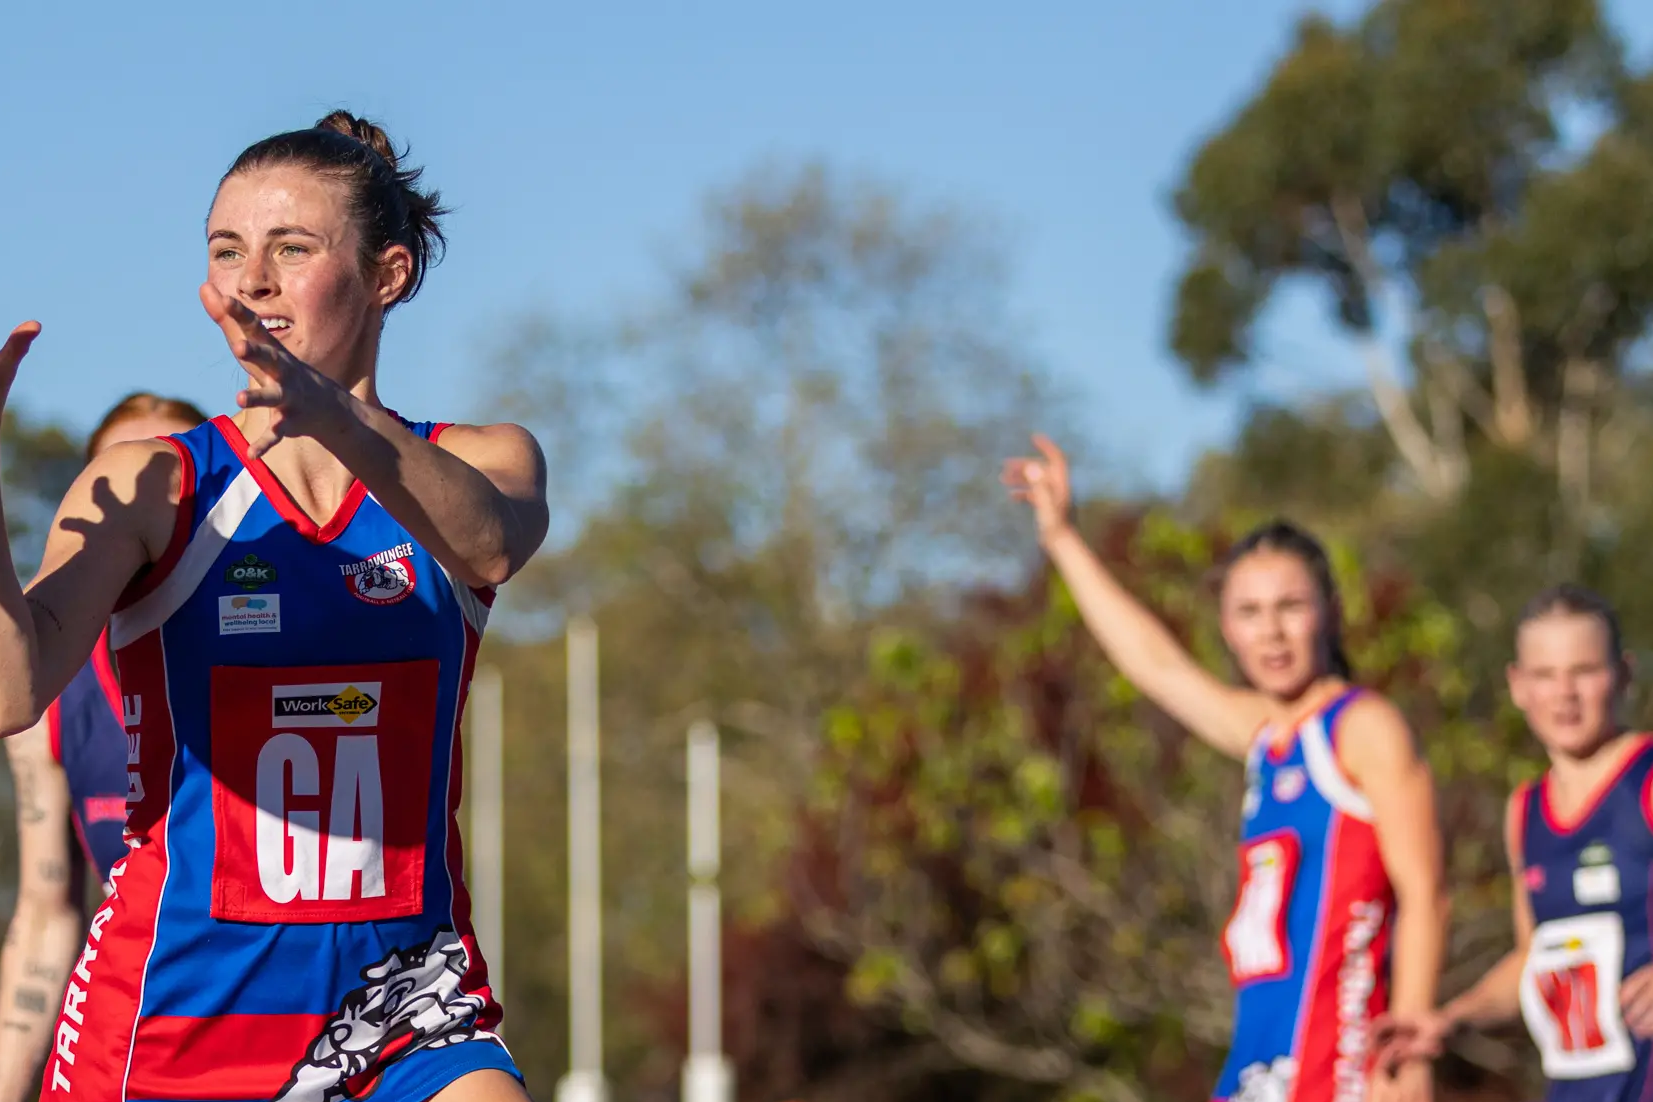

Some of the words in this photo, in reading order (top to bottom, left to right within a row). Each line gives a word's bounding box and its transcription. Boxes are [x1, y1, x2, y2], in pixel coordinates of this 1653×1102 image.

[233, 567, 268, 579] O&K
[338, 542, 415, 576] TARRAWINGEE
[256, 733, 386, 904] GA
